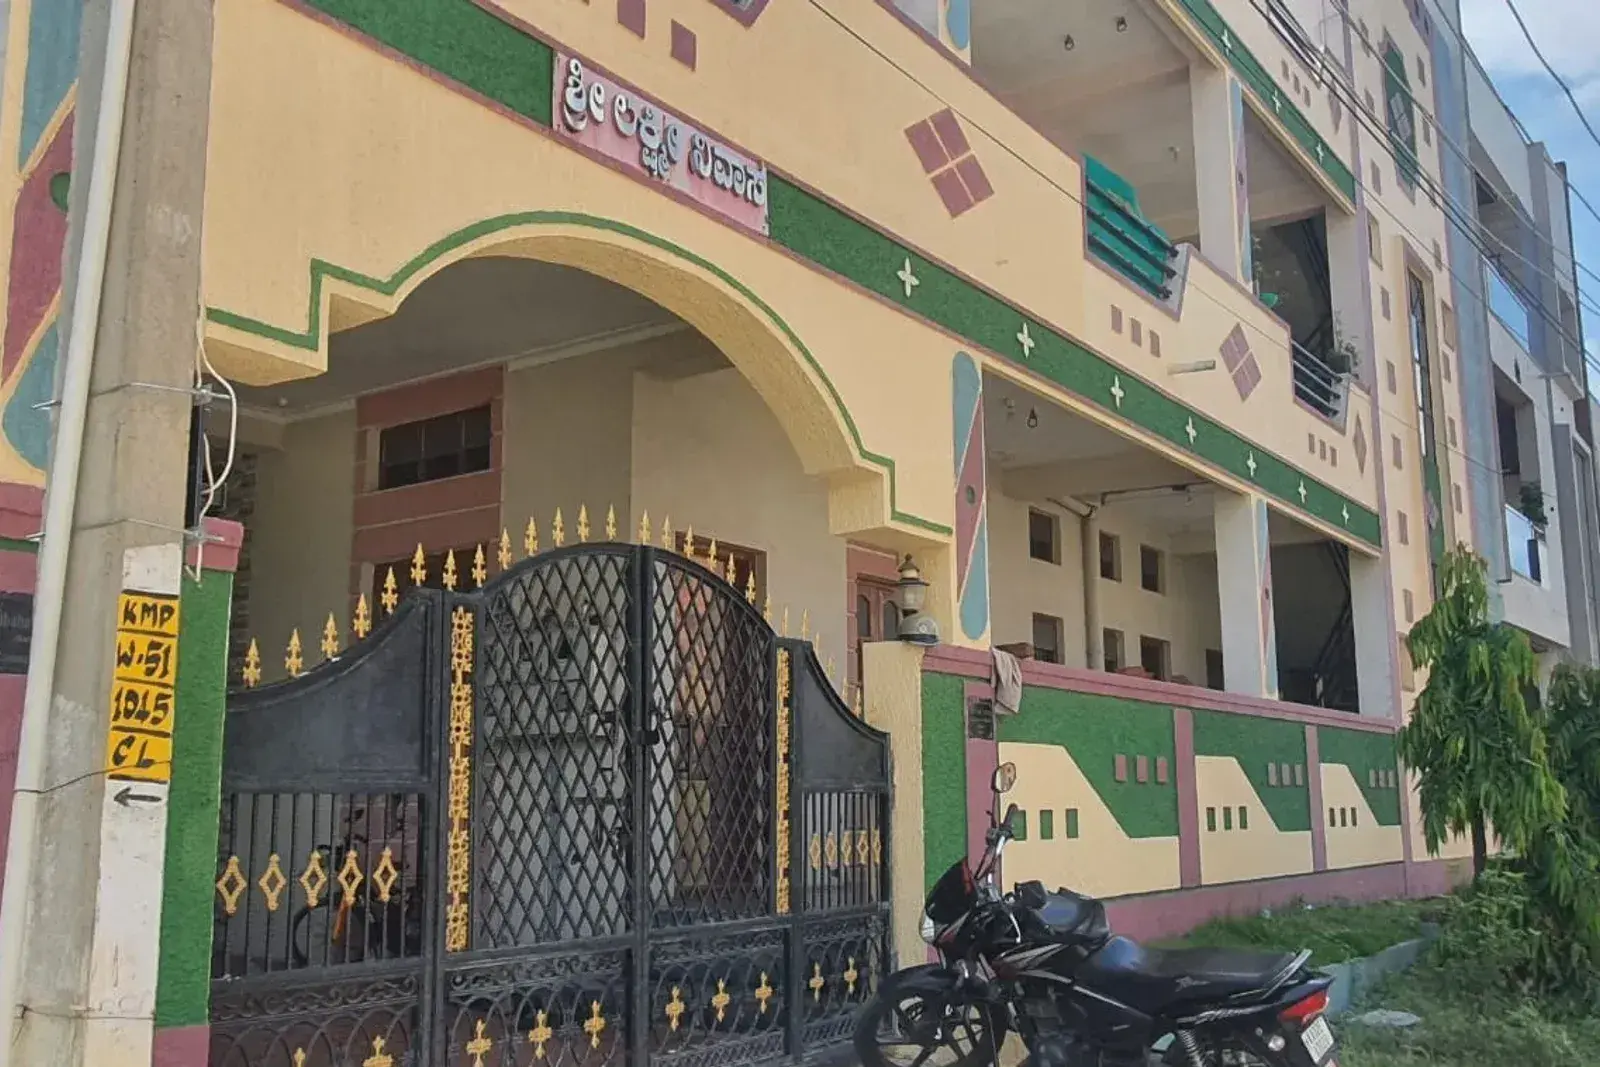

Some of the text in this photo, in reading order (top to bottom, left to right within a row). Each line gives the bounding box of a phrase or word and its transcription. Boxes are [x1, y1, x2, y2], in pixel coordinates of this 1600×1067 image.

[563, 57, 605, 131] ಶ್ರೀ
[691, 131, 766, 206] ನಿವಾಸ
[122, 598, 175, 629] KMP
